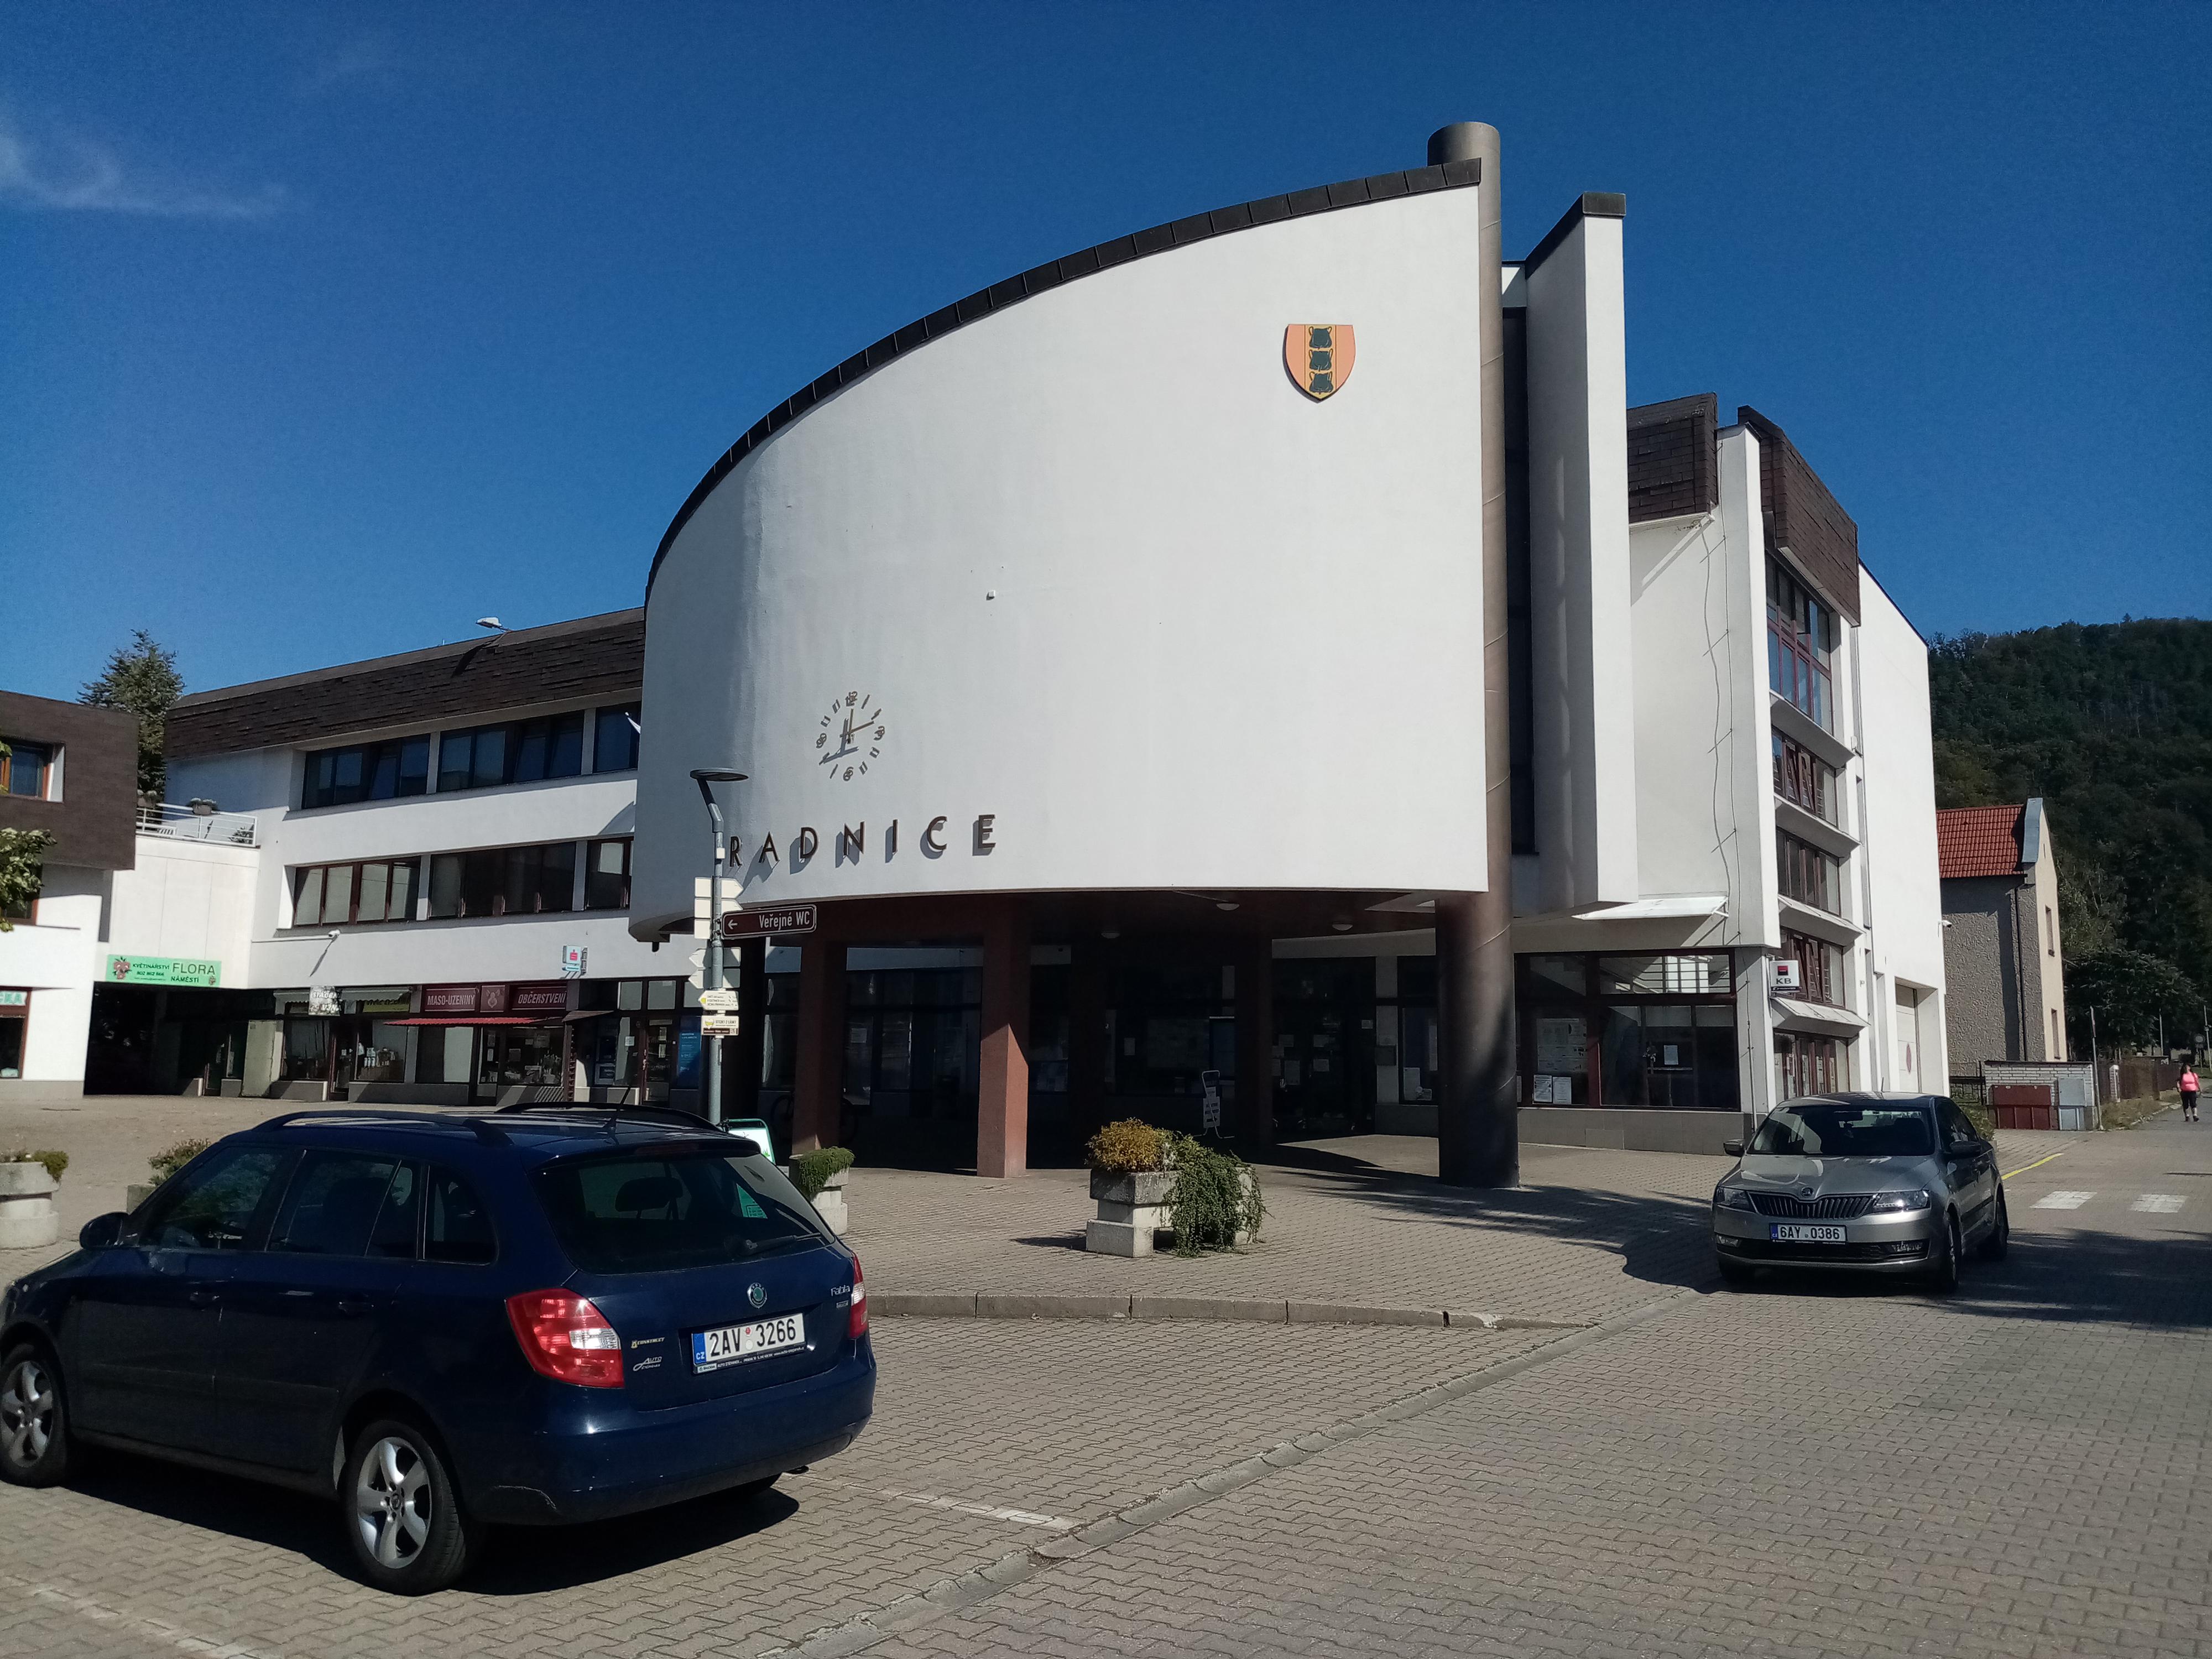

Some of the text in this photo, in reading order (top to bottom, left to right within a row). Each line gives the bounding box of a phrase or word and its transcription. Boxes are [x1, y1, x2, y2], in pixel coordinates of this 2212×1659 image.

[874, 726, 885, 740] 3
[843, 766, 854, 781] 6
[729, 815, 996, 867] RADNICE
[759, 911, 810, 930] Veřejné WC
[172, 963, 215, 975] FLORA
[427, 995, 474, 1005] MASO-UZENINY
[518, 991, 566, 1004] OBČERSTVENÍ
[1781, 1226, 1840, 1239] 6AY 0386
[831, 1285, 850, 1296] Fabia
[709, 1318, 796, 1357] 2AV 3266
[696, 1352, 705, 1360] CZ
